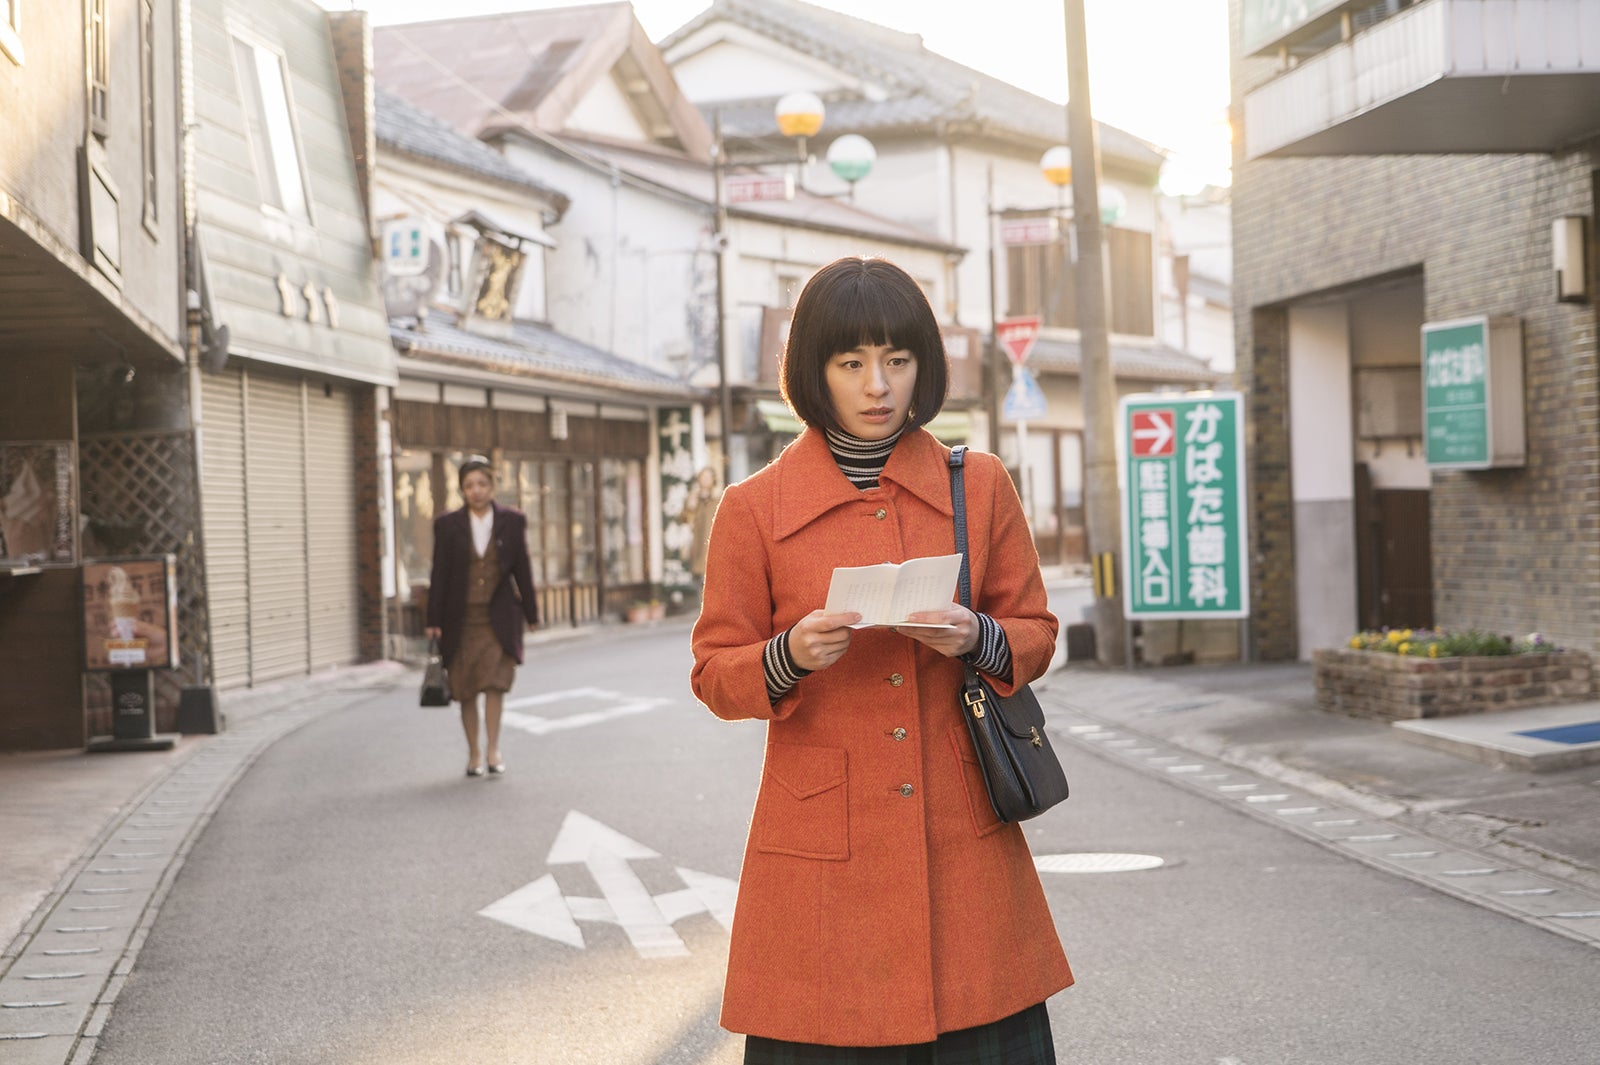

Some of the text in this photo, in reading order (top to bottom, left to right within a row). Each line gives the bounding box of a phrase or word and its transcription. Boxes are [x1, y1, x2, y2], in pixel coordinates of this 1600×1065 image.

[1140, 461, 1170, 605] 駐車場入口
